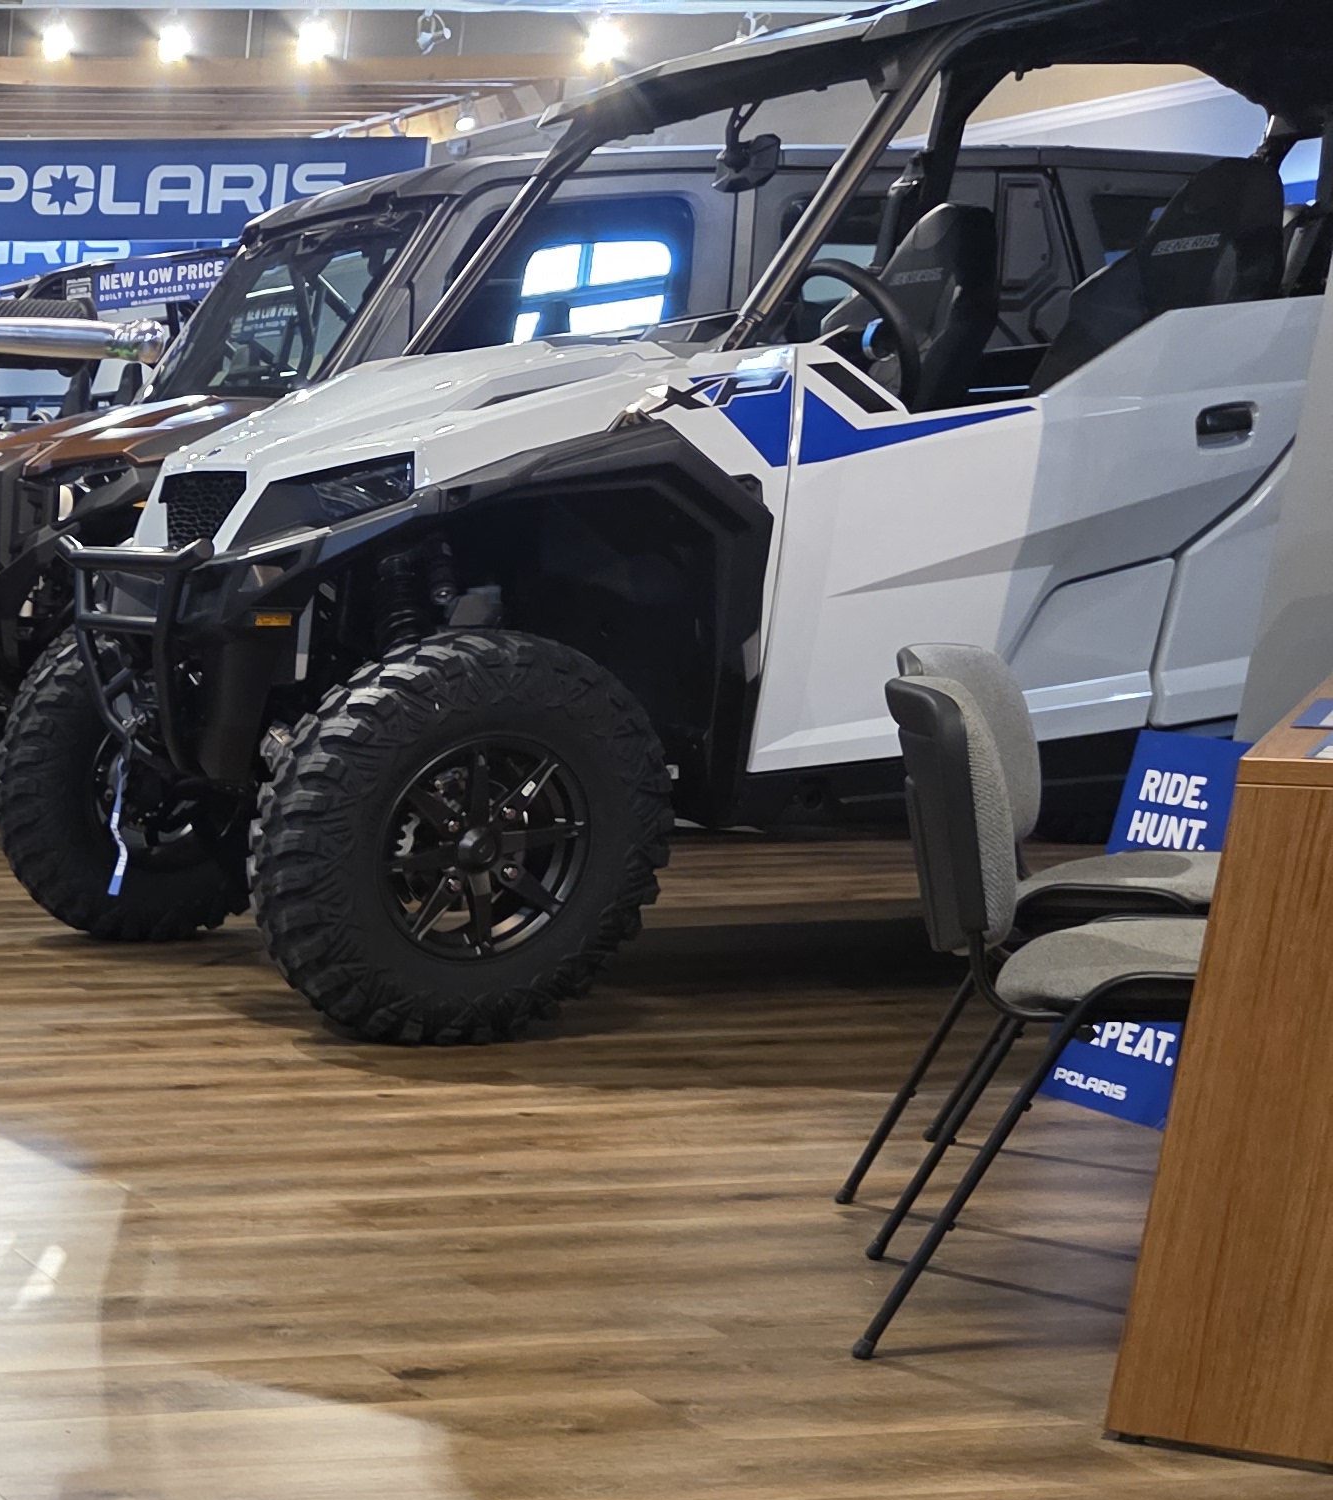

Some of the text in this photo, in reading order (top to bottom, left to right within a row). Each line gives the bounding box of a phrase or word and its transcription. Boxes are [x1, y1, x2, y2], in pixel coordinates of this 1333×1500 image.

[99, 271, 135, 291] NEW
[139, 266, 173, 286] LOW
[177, 260, 225, 281] PRICE
[641, 369, 790, 413] XP
[1139, 769, 1208, 811] RIDE.
[1126, 809, 1208, 851] HUNT.
[1053, 1066, 1127, 1101] POLARIS
